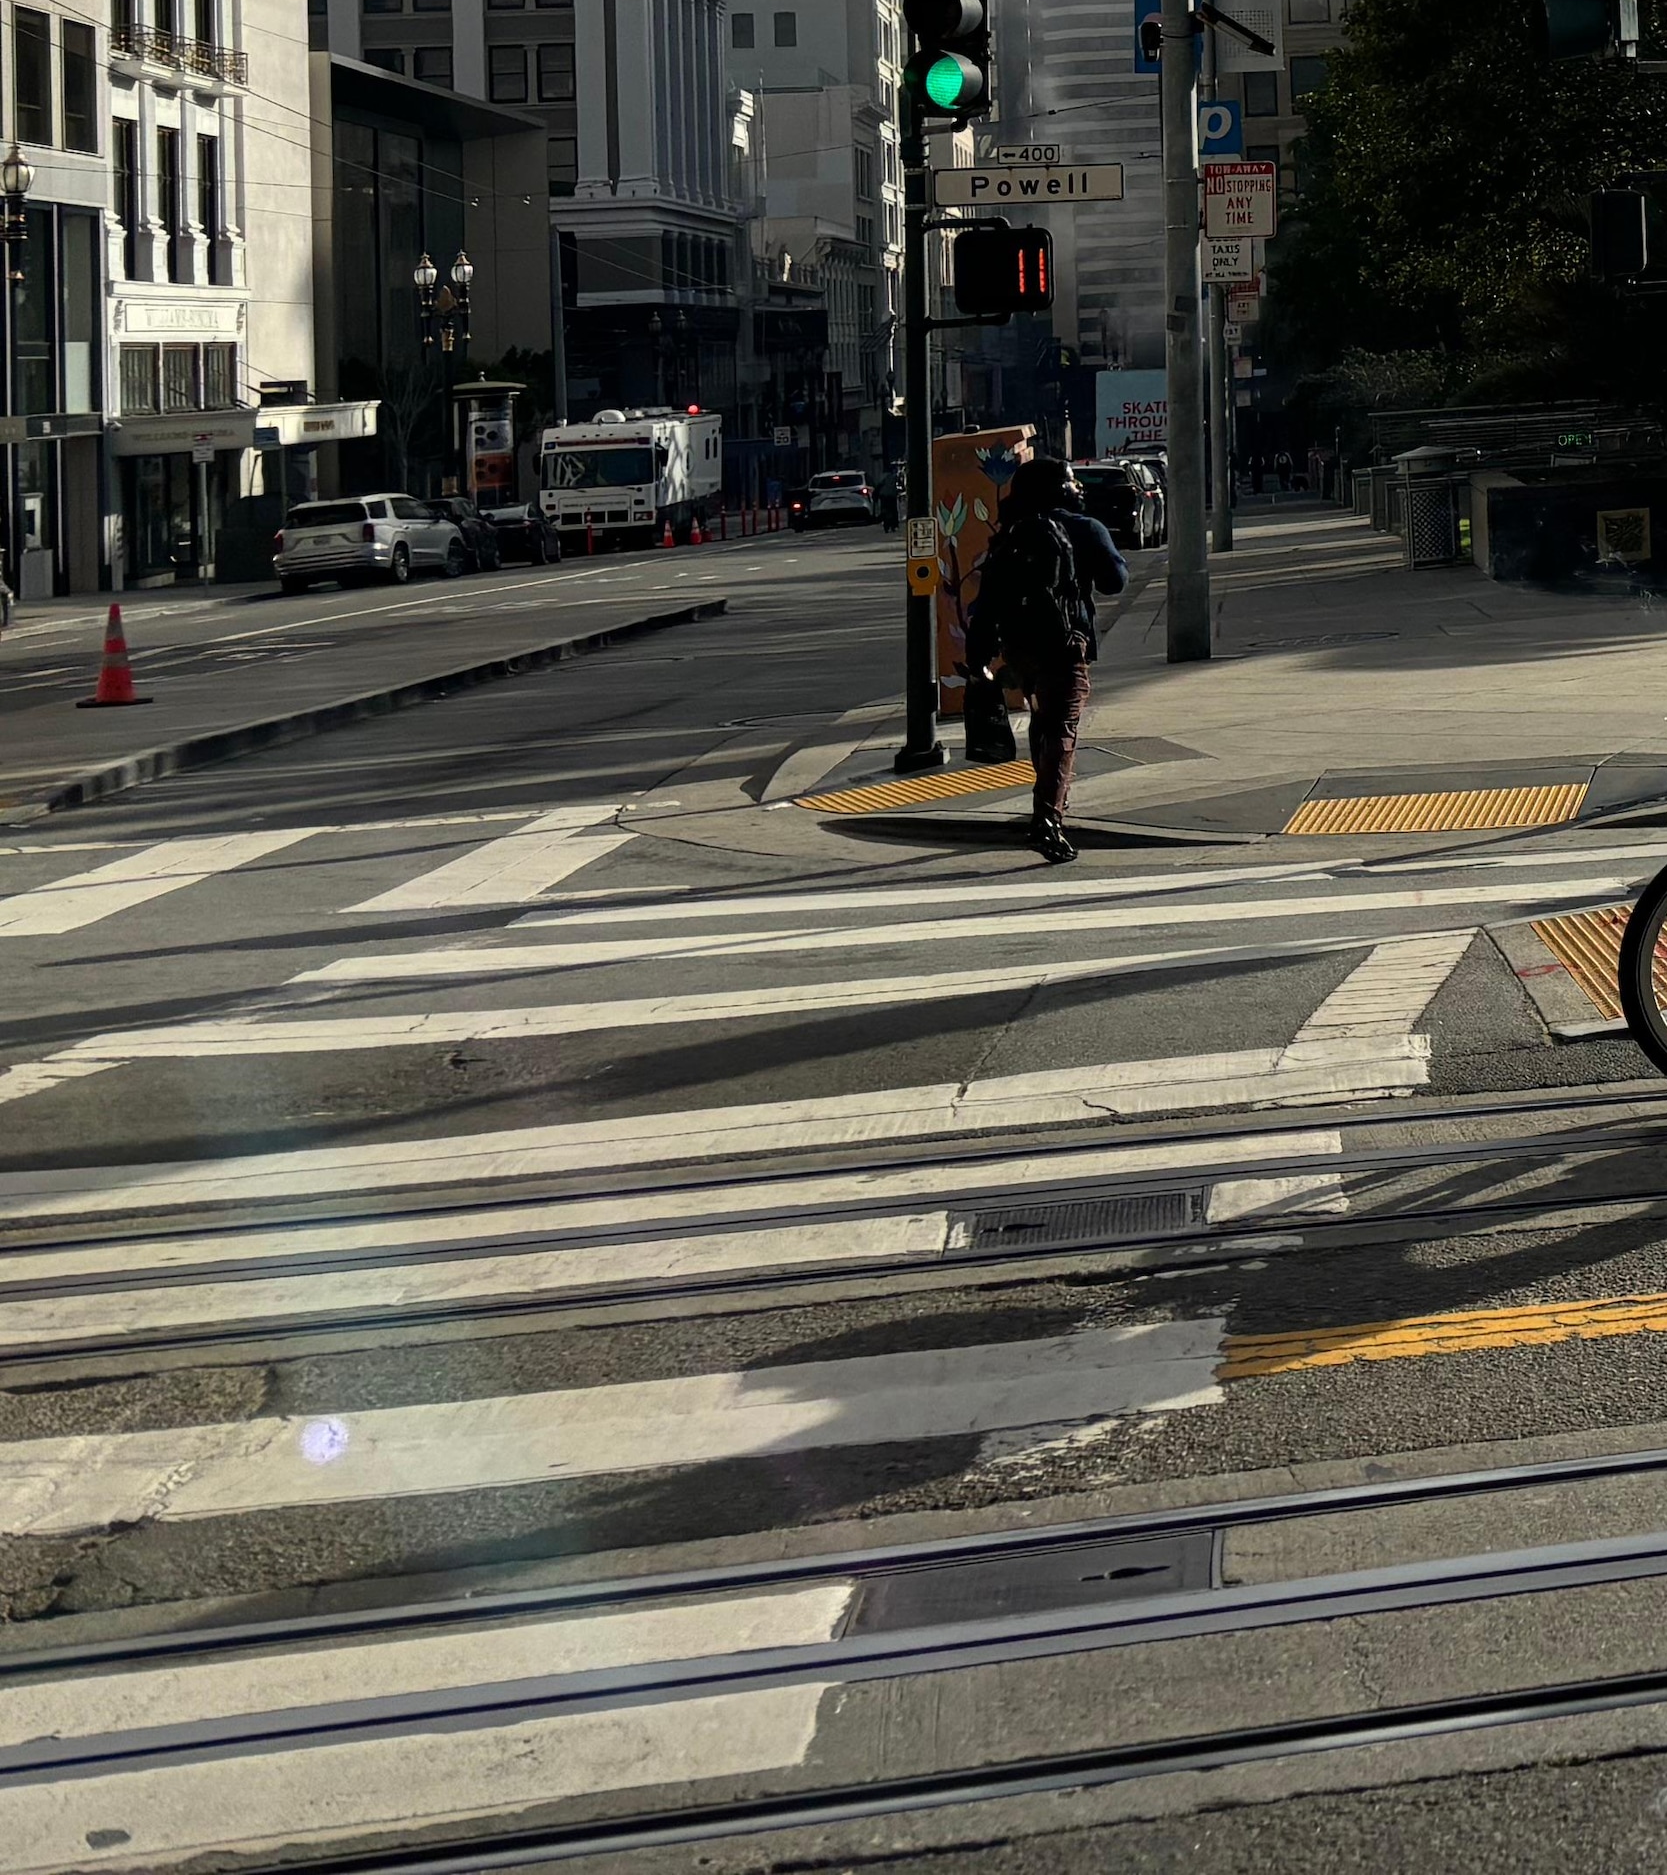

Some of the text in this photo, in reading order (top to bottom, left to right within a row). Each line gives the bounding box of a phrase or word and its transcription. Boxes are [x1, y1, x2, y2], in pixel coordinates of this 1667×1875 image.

[1019, 147, 1055, 162] 400
[1209, 165, 1267, 175] TOW-AWAY
[971, 172, 1087, 198] Powell
[1206, 176, 1272, 194] NO STOPPING
[1226, 197, 1253, 210] ANY
[1225, 211, 1255, 225] TIME
[1211, 244, 1240, 254] TAXIS
[1212, 257, 1239, 267] ONLY
[1106, 416, 1167, 429] THROU
[1131, 430, 1162, 441] THE
